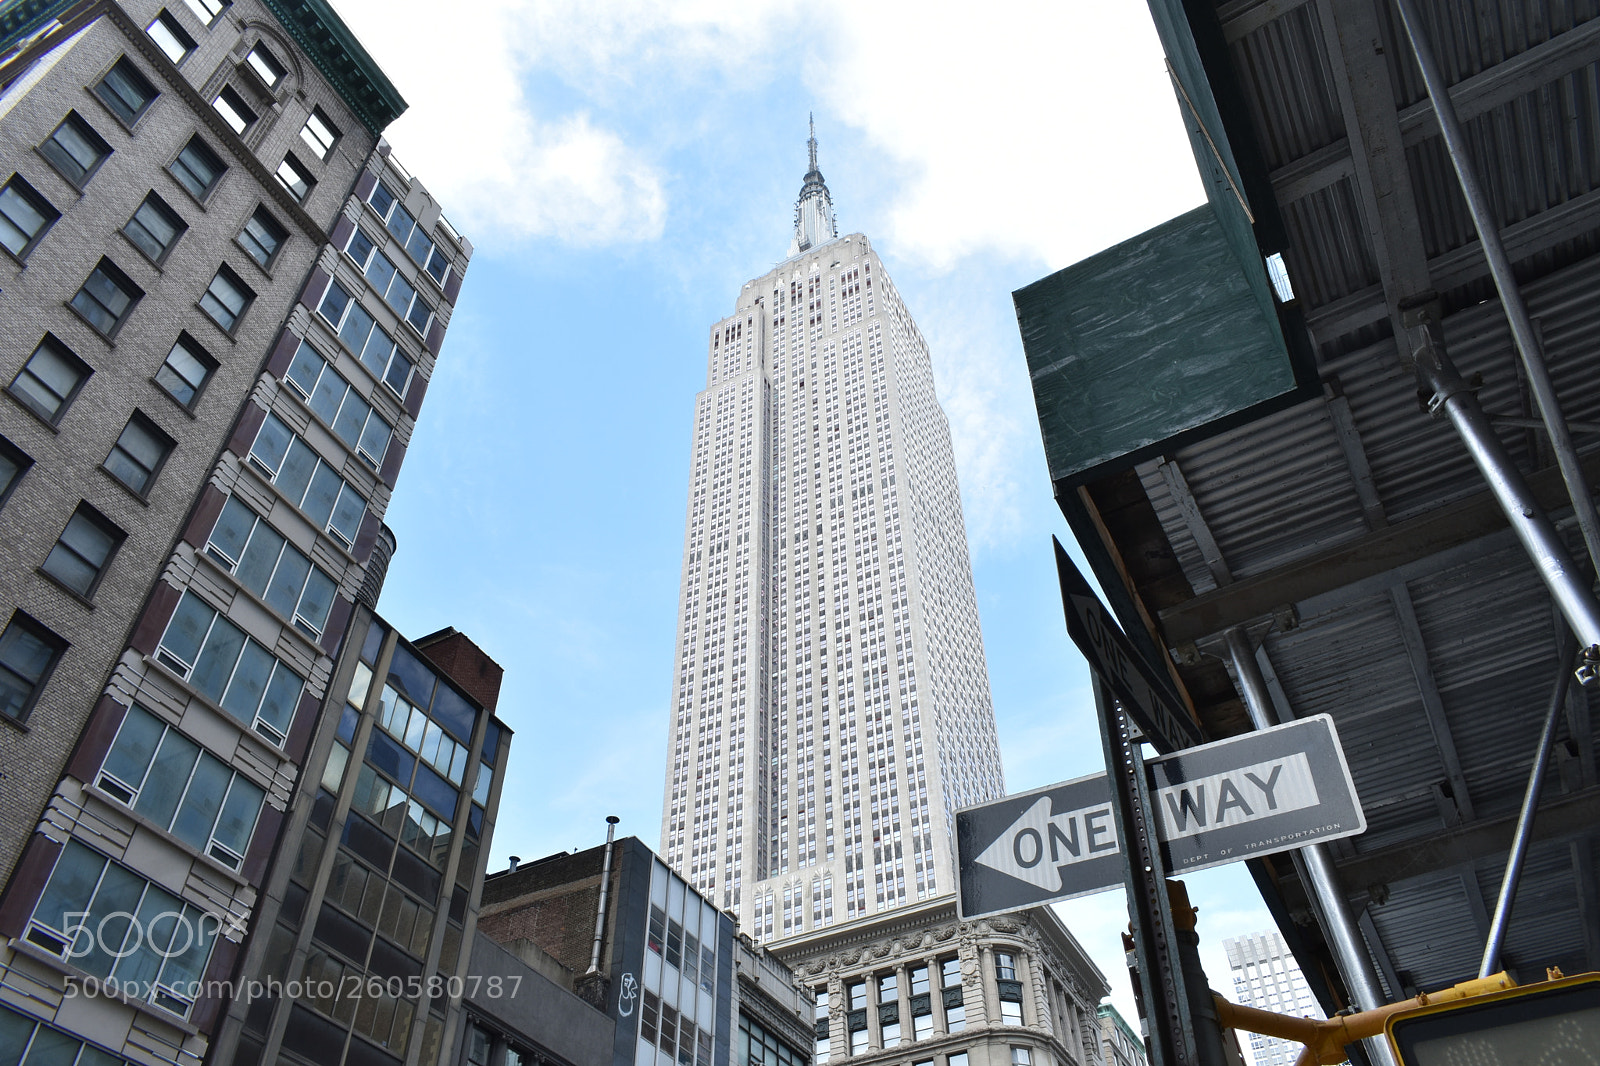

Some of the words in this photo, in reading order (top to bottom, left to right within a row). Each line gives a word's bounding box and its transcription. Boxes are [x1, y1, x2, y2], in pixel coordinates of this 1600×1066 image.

[1086, 608, 1134, 692] ONE
[1013, 808, 1116, 869] ONE
[1165, 764, 1283, 833] WAY
[1183, 853, 1209, 864] DEPT
[1220, 847, 1233, 856] OF
[1244, 823, 1342, 850] TRANSPORTATION
